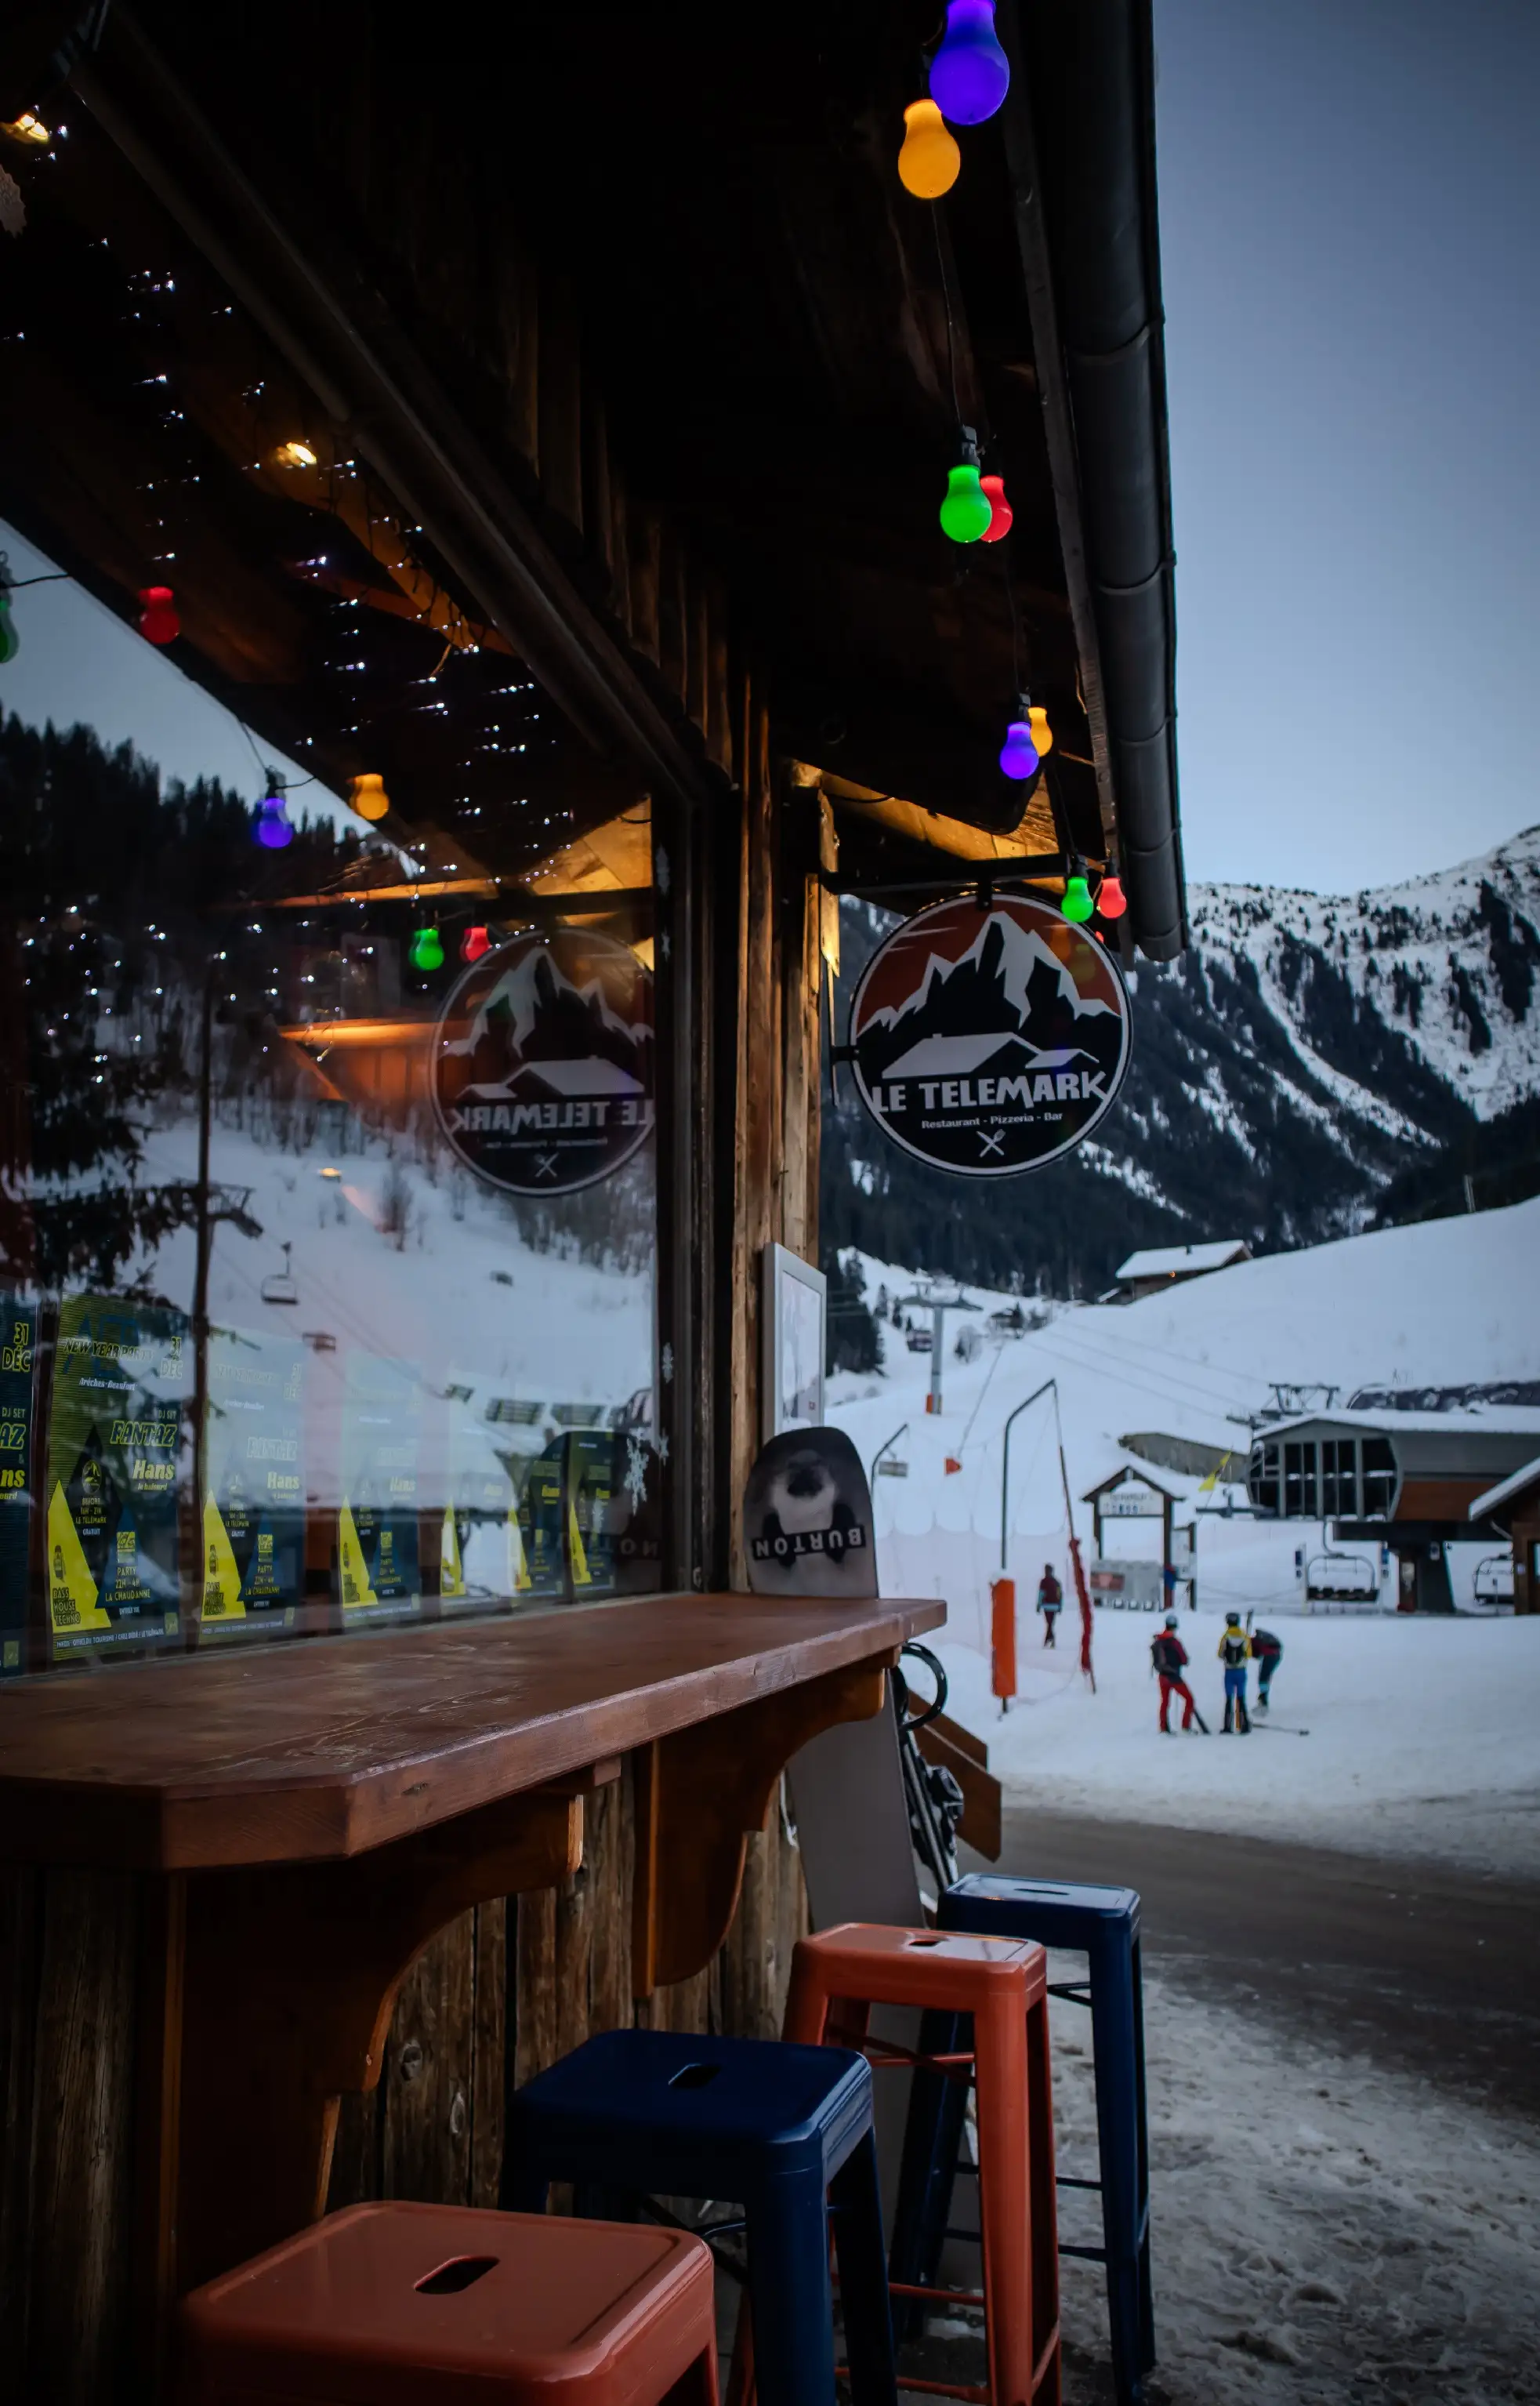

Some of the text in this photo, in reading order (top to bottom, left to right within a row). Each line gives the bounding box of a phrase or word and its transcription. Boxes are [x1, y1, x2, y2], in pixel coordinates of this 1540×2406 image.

[871, 1070, 1109, 1112] LE TELEMARK
[921, 1117, 980, 1130] Restaurant
[990, 1112, 1035, 1124] Pizzeria
[1043, 1111, 1064, 1122] Bar
[13, 1322, 29, 1345] 31
[2, 1406, 26, 1418] DJ SET
[110, 1420, 178, 1448] FANTAZ
[132, 1459, 176, 1480] Hans
[266, 1471, 300, 1490] Hans
[754, 1526, 862, 1559] BURTON
[117, 1566, 137, 1577] PARTY
[53, 1587, 70, 1599] BASS
[53, 1599, 76, 1612] HOUSE
[54, 1612, 82, 1626] TECHNO
